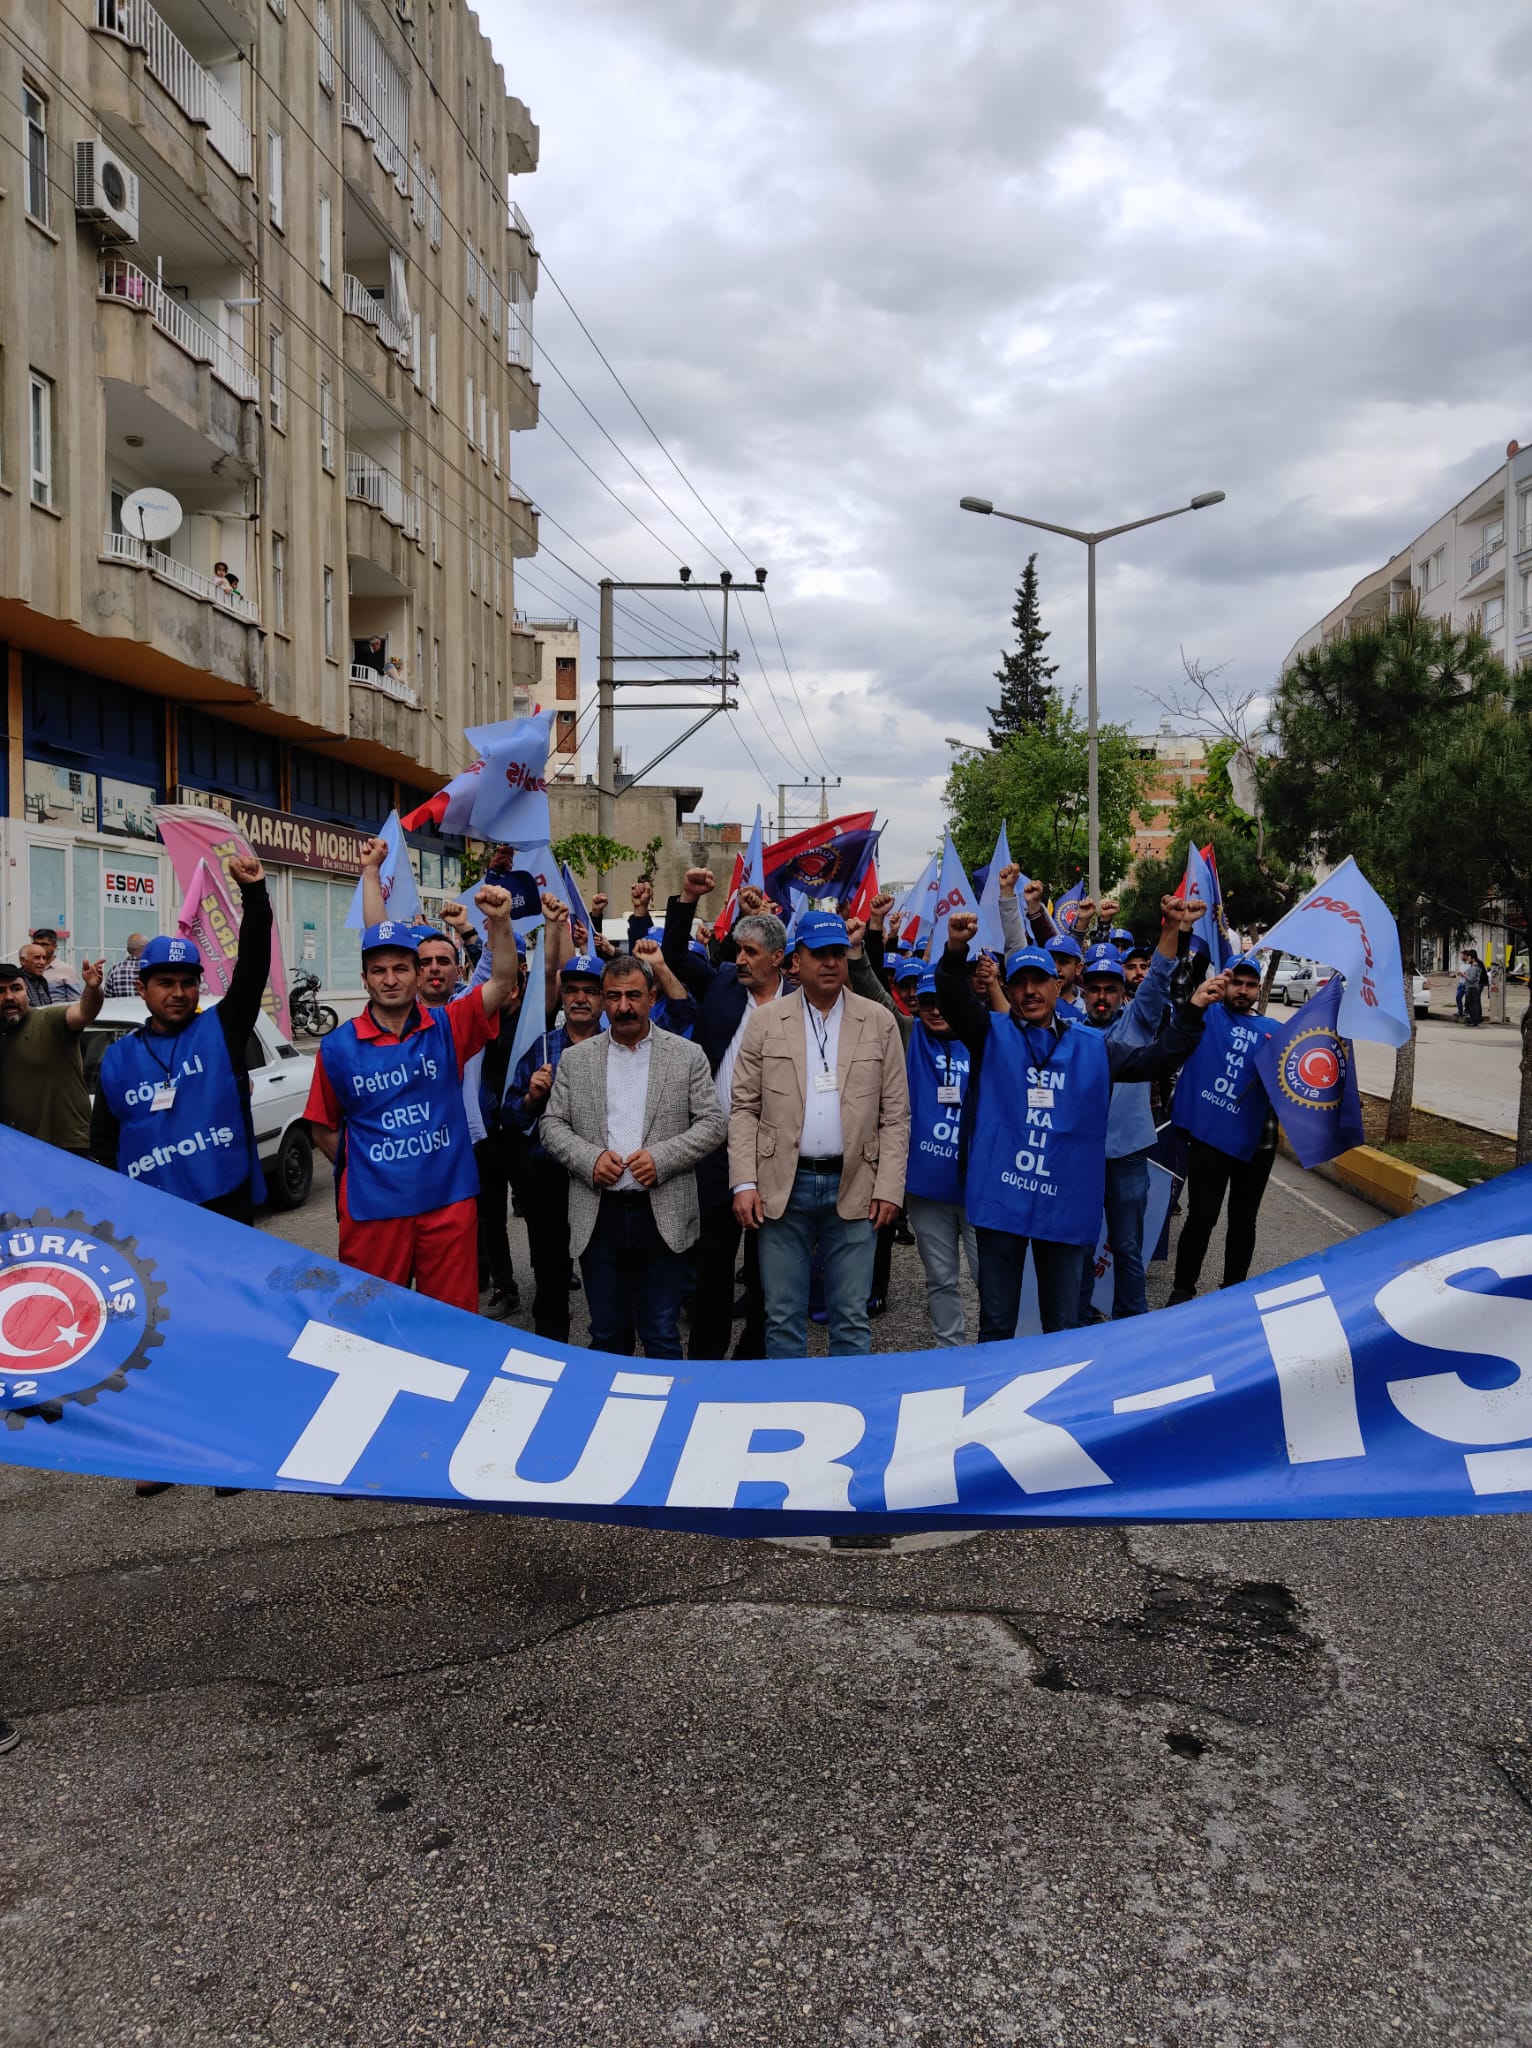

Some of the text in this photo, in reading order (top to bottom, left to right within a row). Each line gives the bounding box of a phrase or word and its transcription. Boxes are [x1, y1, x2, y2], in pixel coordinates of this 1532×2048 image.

[236, 810, 312, 862] KARATAŞ
[106, 873, 154, 894] ESBAB
[1230, 1026, 1258, 1044] SEN
[1226, 1052, 1244, 1069] KA
[1026, 1066, 1065, 1090] SEN
[1214, 1077, 1238, 1100] OL
[381, 1101, 430, 1130] GREV
[1026, 1108, 1053, 1129] KA
[127, 1127, 234, 1179] petrol-iş
[369, 1124, 451, 1162] GÖZCÜSÜ
[920, 1140, 953, 1158] GÜÇLÜ
[1015, 1150, 1051, 1177] OL
[1001, 1171, 1038, 1192] GÜÇLÜ
[0, 1232, 136, 1313] ÜRK-İŞ
